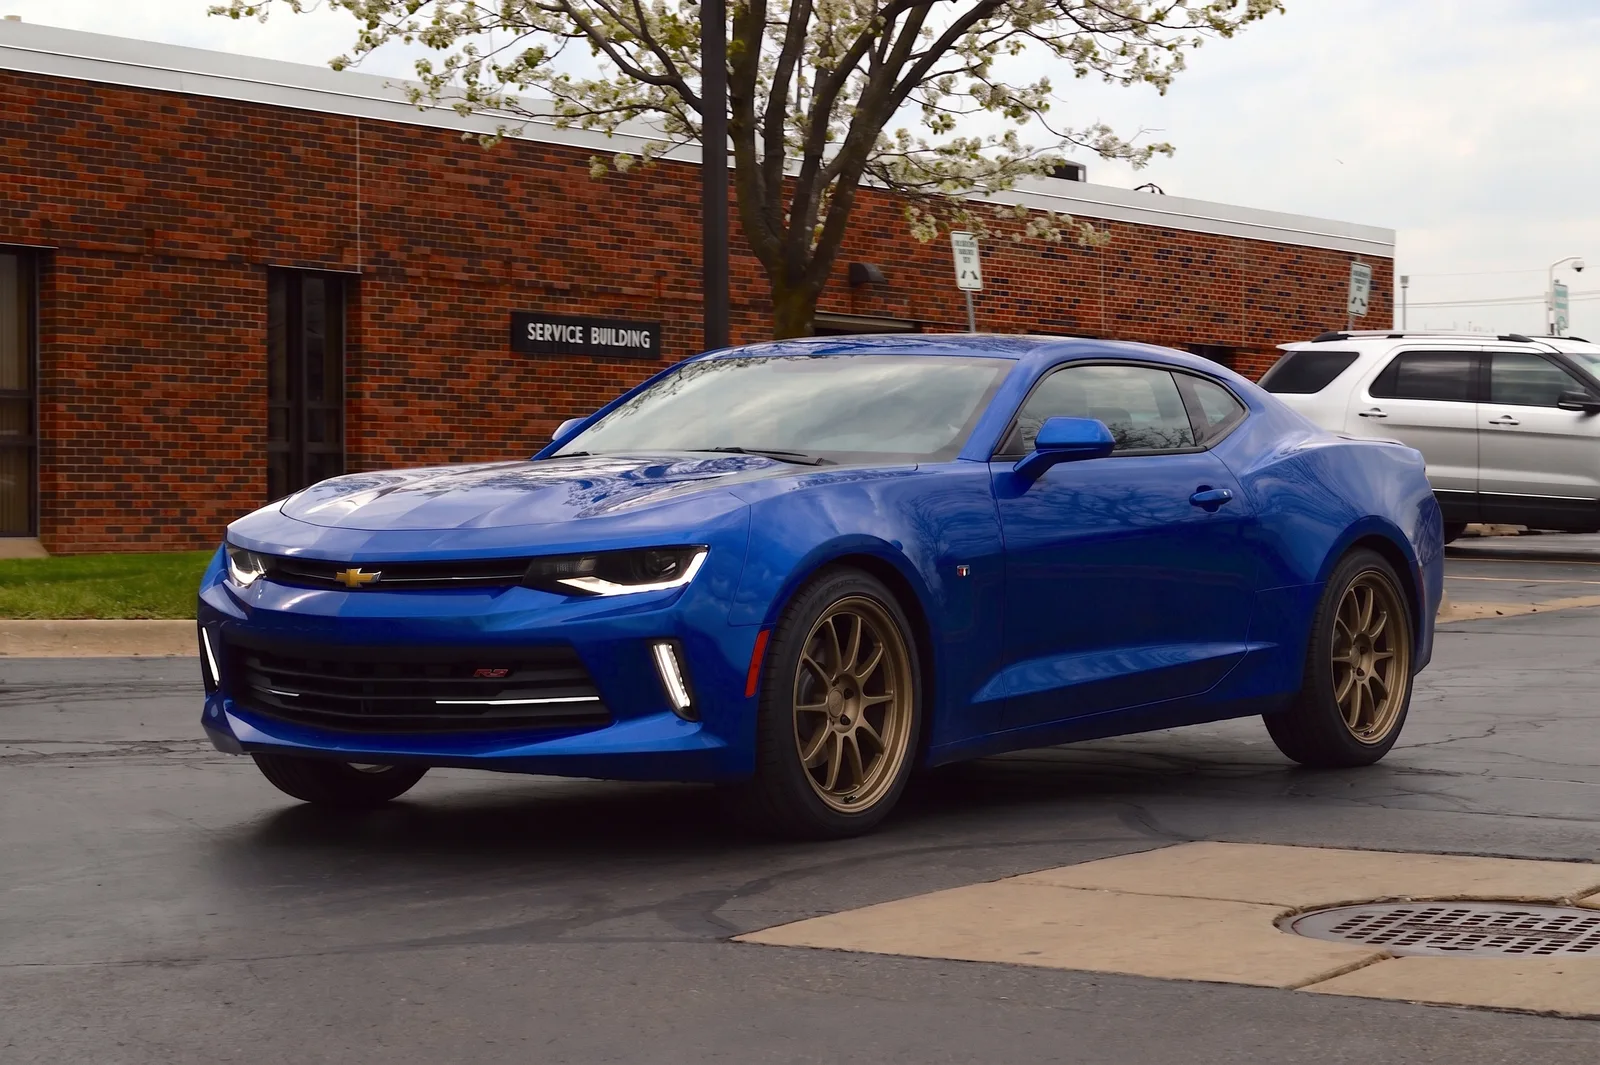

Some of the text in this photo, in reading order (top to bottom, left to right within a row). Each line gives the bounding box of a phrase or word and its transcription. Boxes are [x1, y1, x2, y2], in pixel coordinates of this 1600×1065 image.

[527, 322, 651, 349] SERVICE BUILDING
[473, 668, 509, 678] RS
